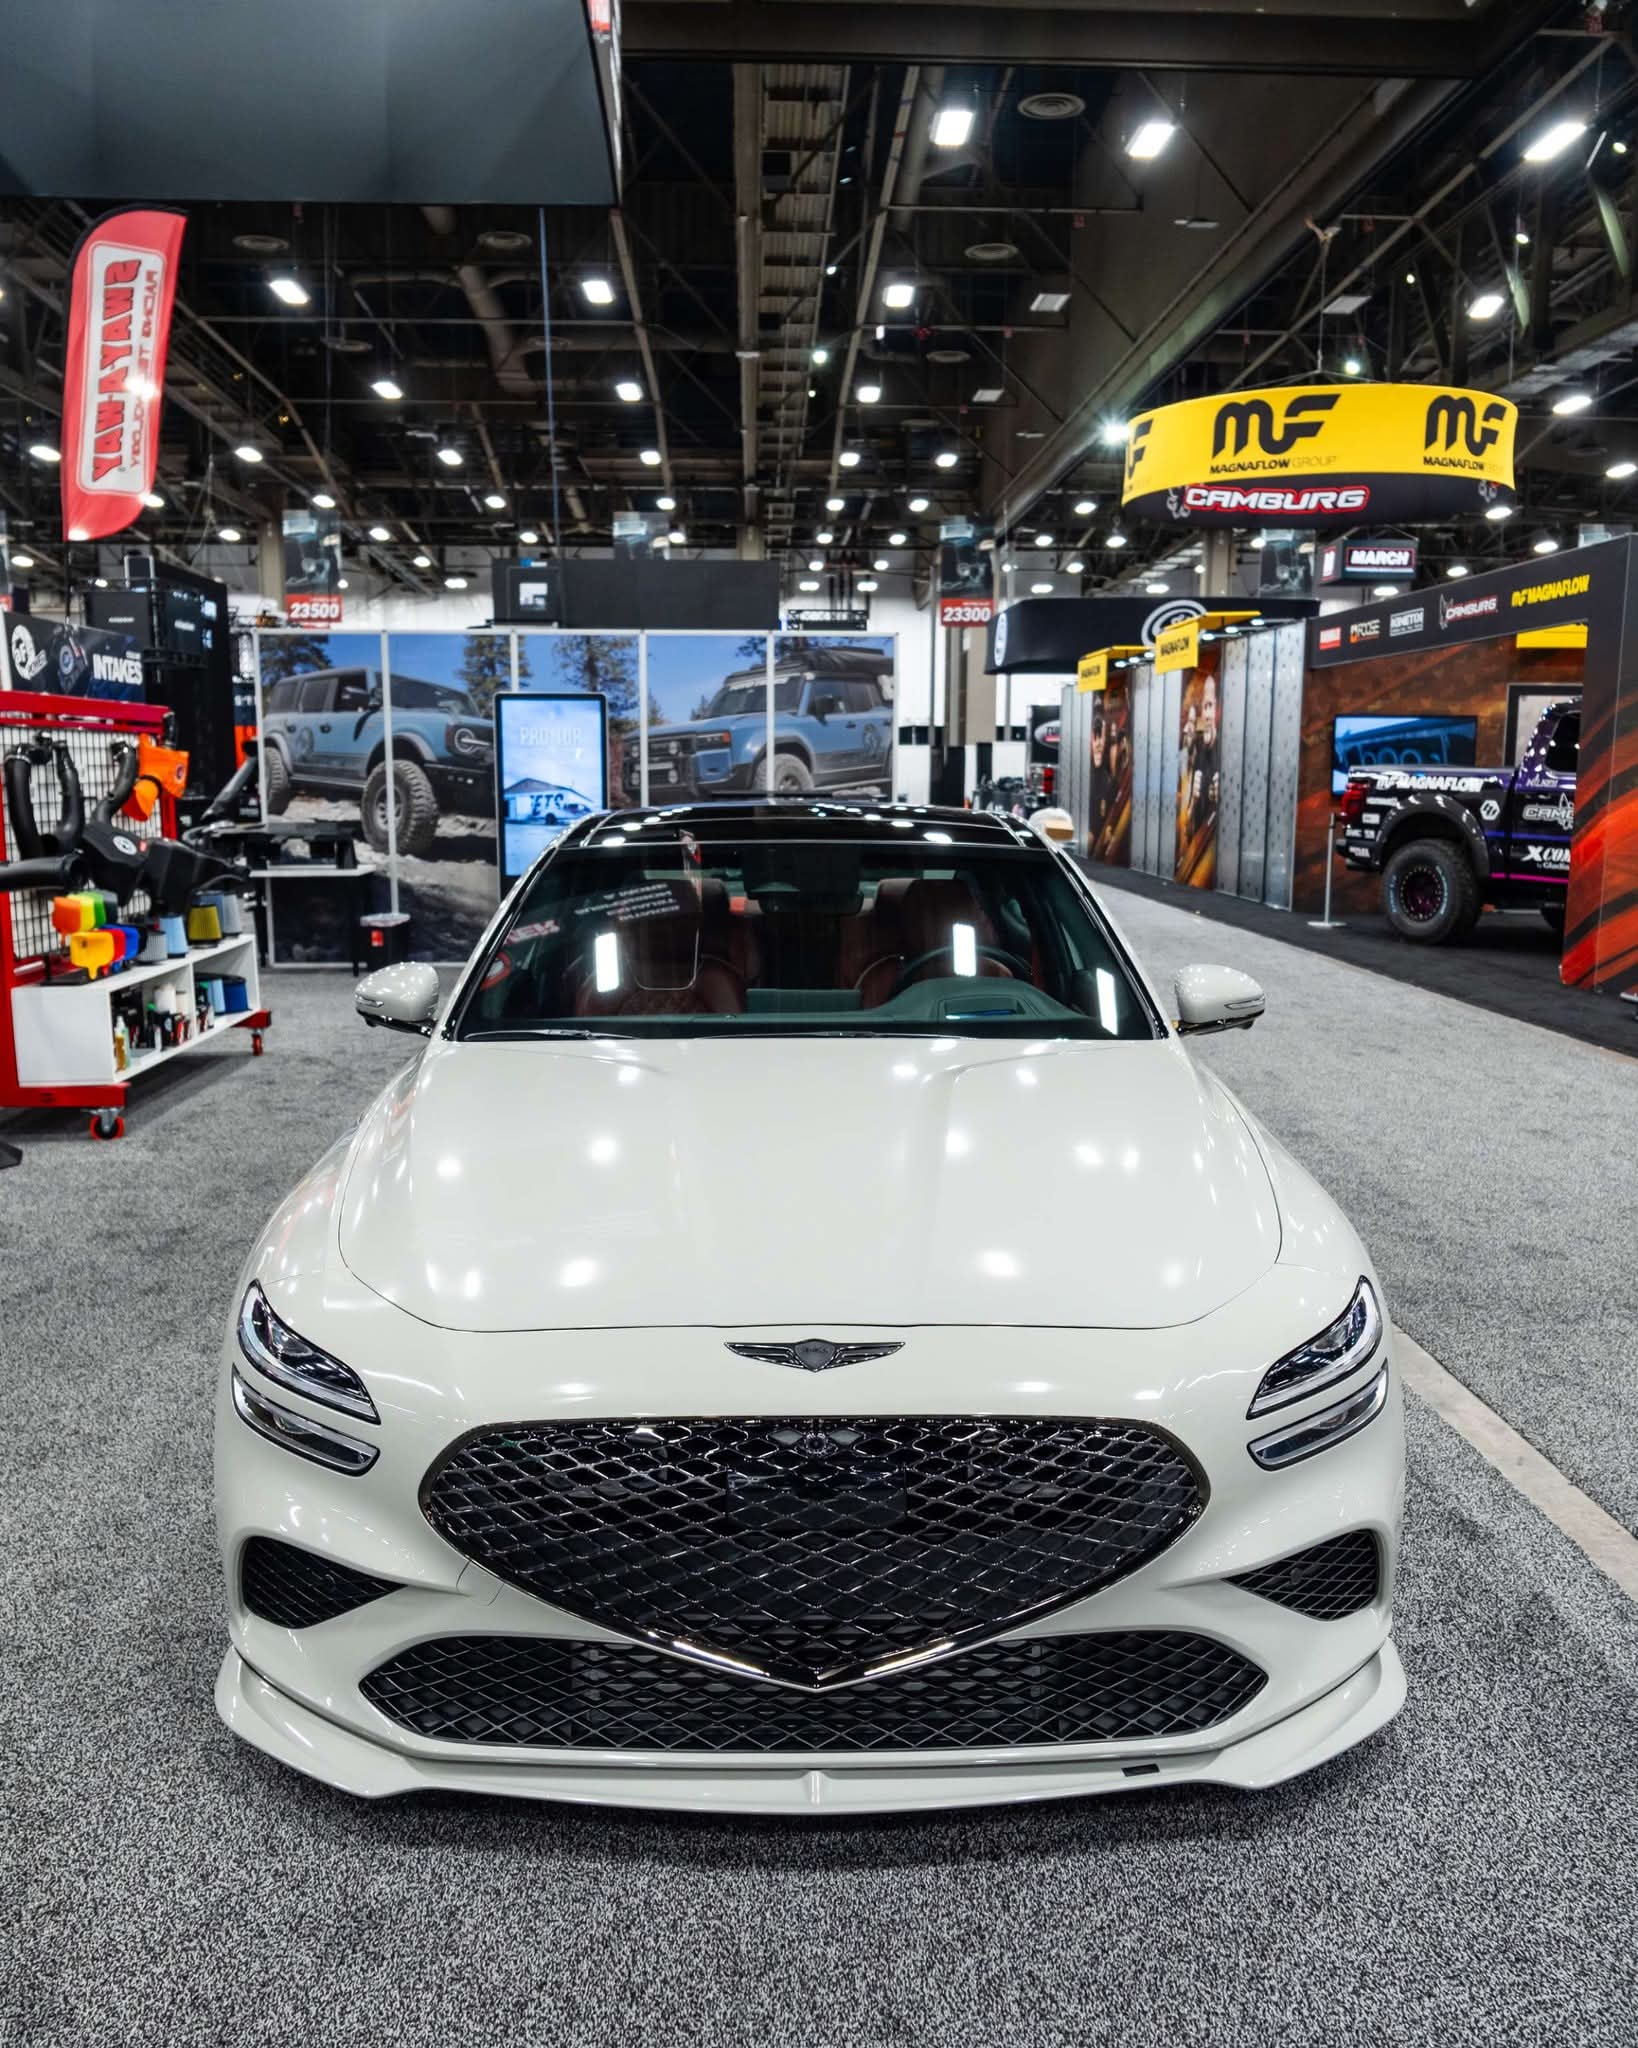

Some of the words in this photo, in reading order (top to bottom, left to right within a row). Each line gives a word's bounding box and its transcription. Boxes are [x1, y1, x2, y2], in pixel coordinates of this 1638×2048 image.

[1209, 458, 1290, 474] MAGNAFLOW
[1423, 456, 1484, 471] MAGNAFLOW
[1184, 486, 1367, 513] CAMBURG
[1350, 550, 1410, 566] MARCH
[1527, 574, 1591, 604] MAGNAFLOW
[290, 602, 340, 619] 23500
[943, 606, 991, 622] 23300
[1445, 598, 1498, 620] CAMBURG
[92, 653, 144, 686] INTAKES
[1397, 776, 1484, 792] MAGNAFLOW
